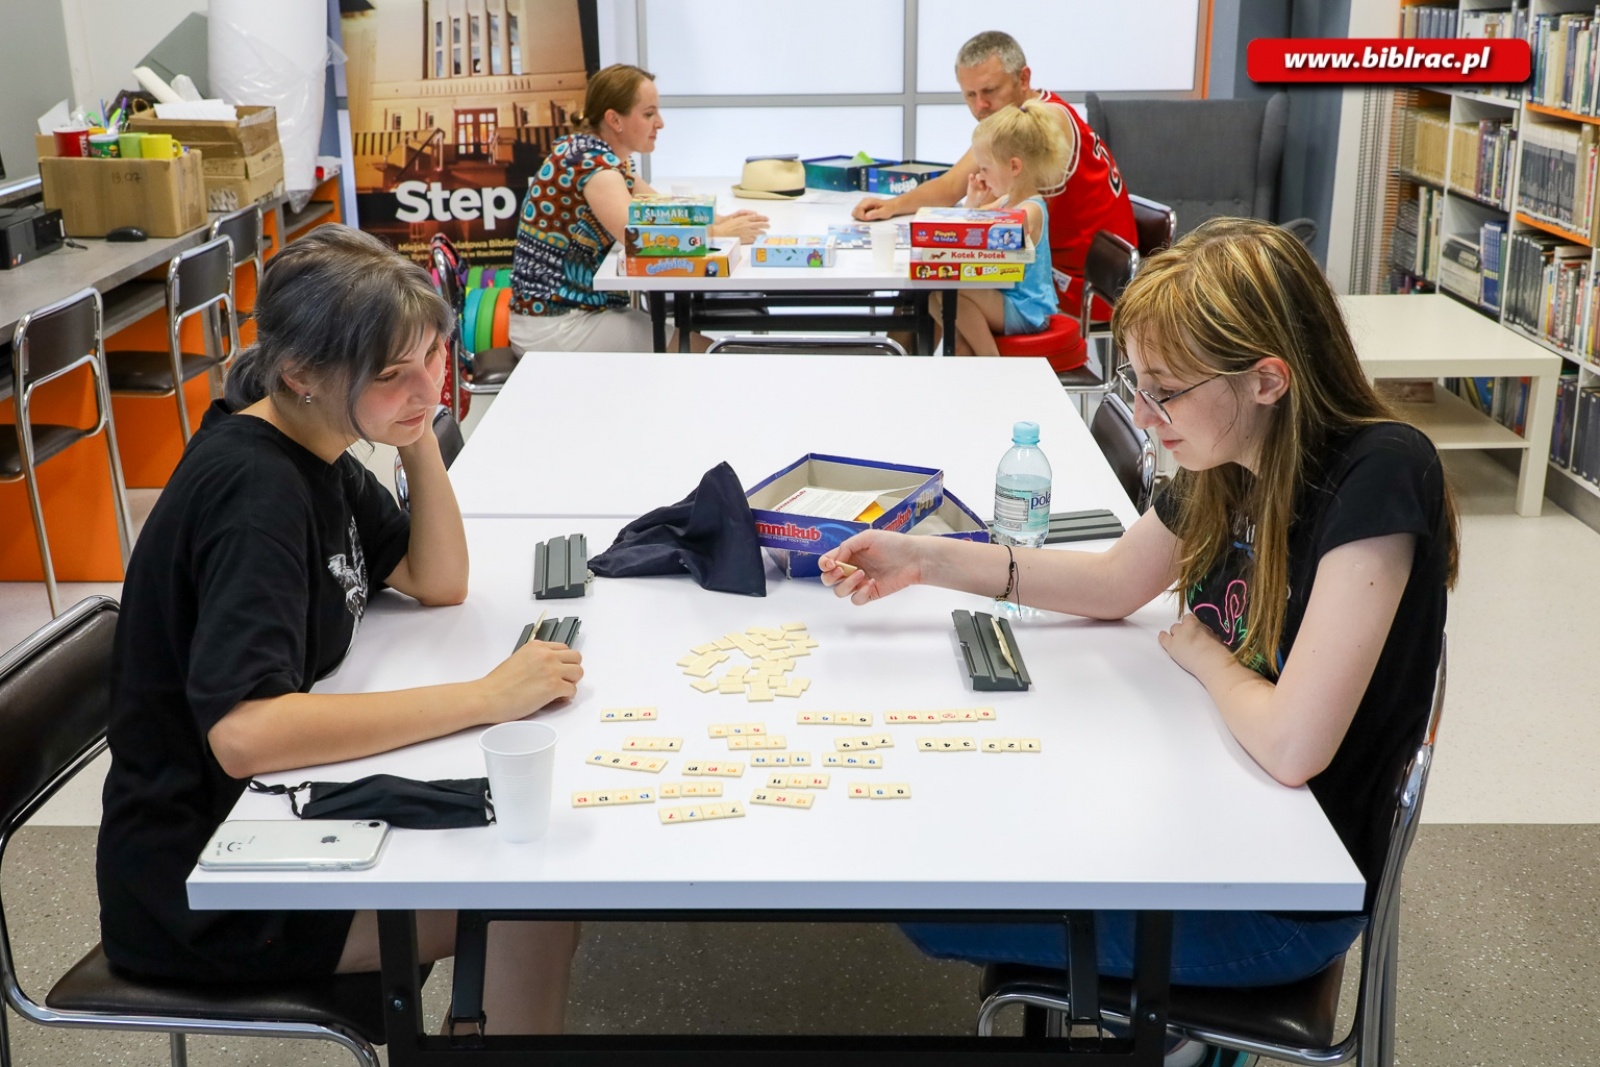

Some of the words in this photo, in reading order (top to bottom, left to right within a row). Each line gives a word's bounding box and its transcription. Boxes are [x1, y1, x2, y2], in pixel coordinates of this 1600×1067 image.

[395, 180, 517, 231] Step
[641, 232, 680, 248] Leo
[951, 251, 975, 260] Kotek
[978, 251, 1006, 260] Psotek
[755, 522, 822, 541] mmikub
